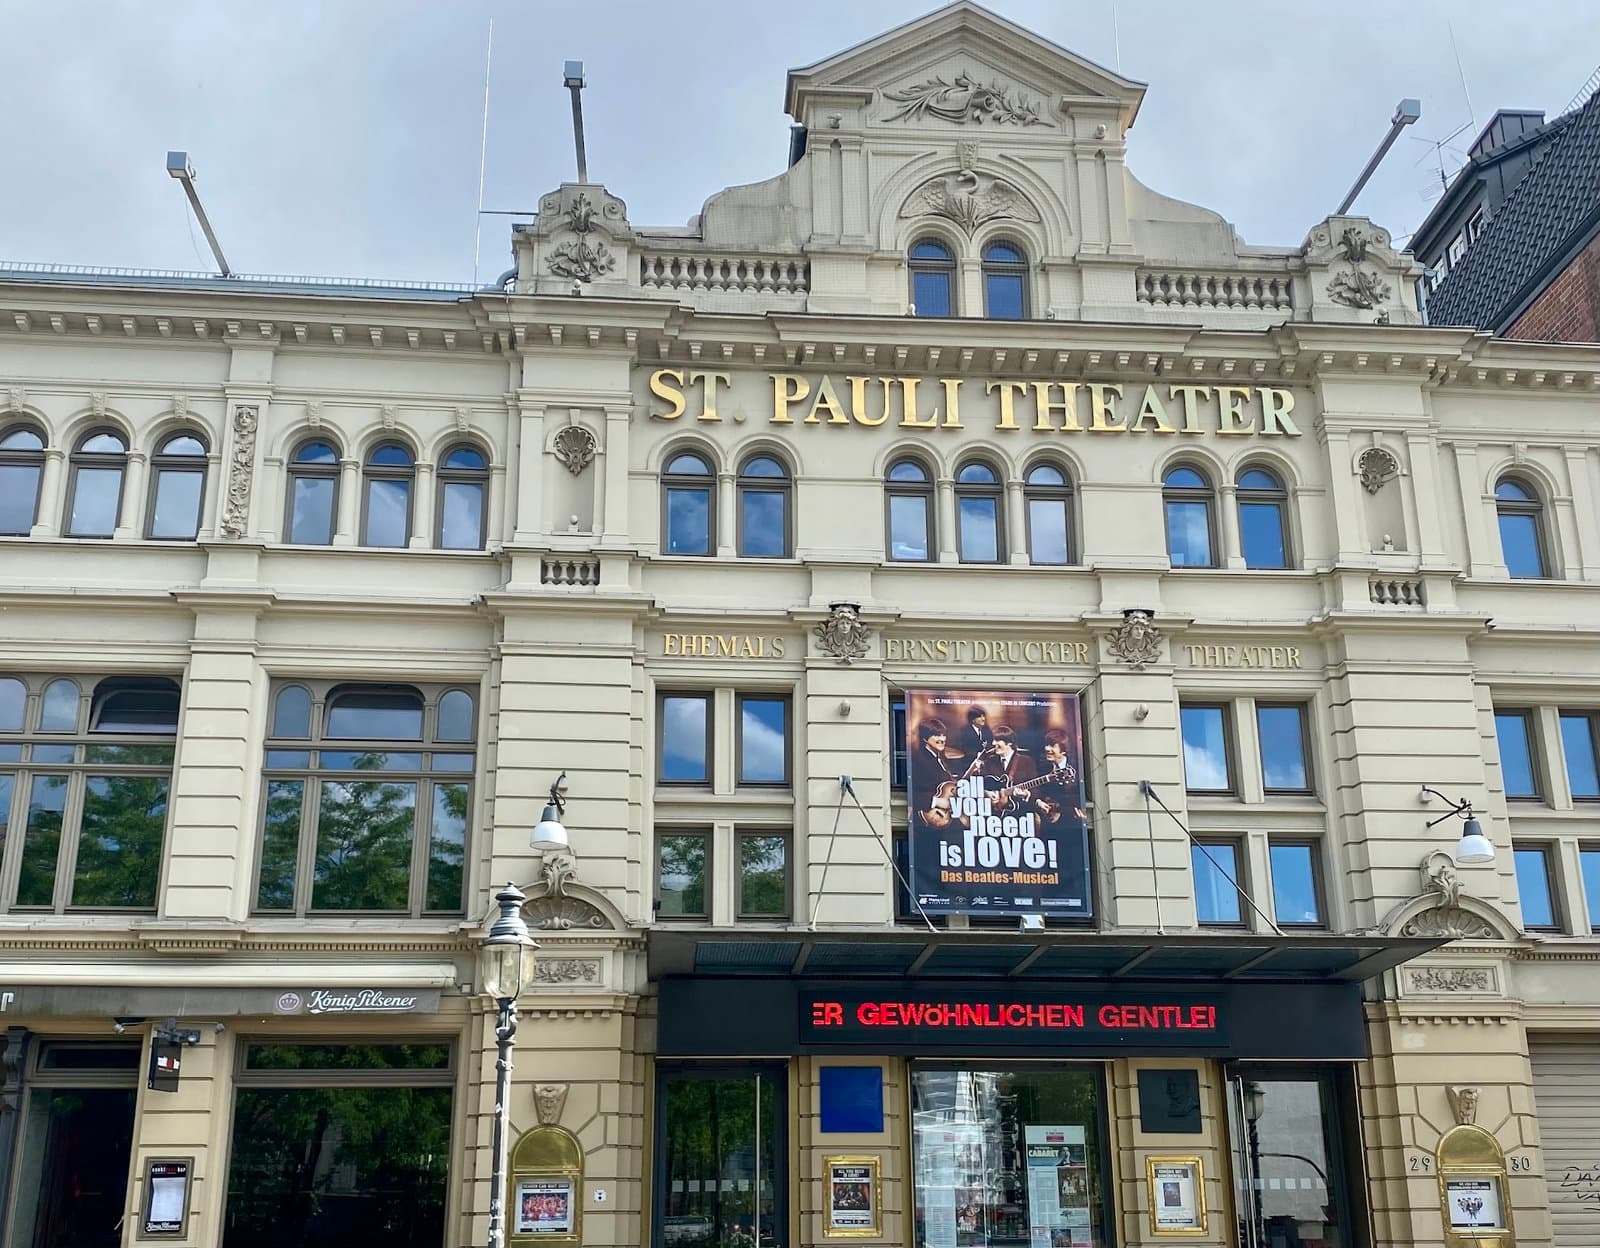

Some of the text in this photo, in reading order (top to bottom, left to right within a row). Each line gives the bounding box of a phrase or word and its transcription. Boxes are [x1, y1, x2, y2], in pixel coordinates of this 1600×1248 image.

[649, 369, 1303, 436] ST. PAULI THEATER
[663, 633, 786, 658] EHEMALS
[885, 639, 1090, 664] ERNST DRUCKER
[1184, 645, 1302, 669] THEATER
[957, 775, 985, 798] all
[950, 796, 992, 818] you
[970, 812, 1035, 838] need
[940, 829, 1058, 869] is love!
[941, 870, 1059, 885] Das Beatles-Musical
[307, 989, 417, 1012] König Pilsener
[1410, 1156, 1431, 1171] 29
[1510, 1156, 1531, 1172] 30
